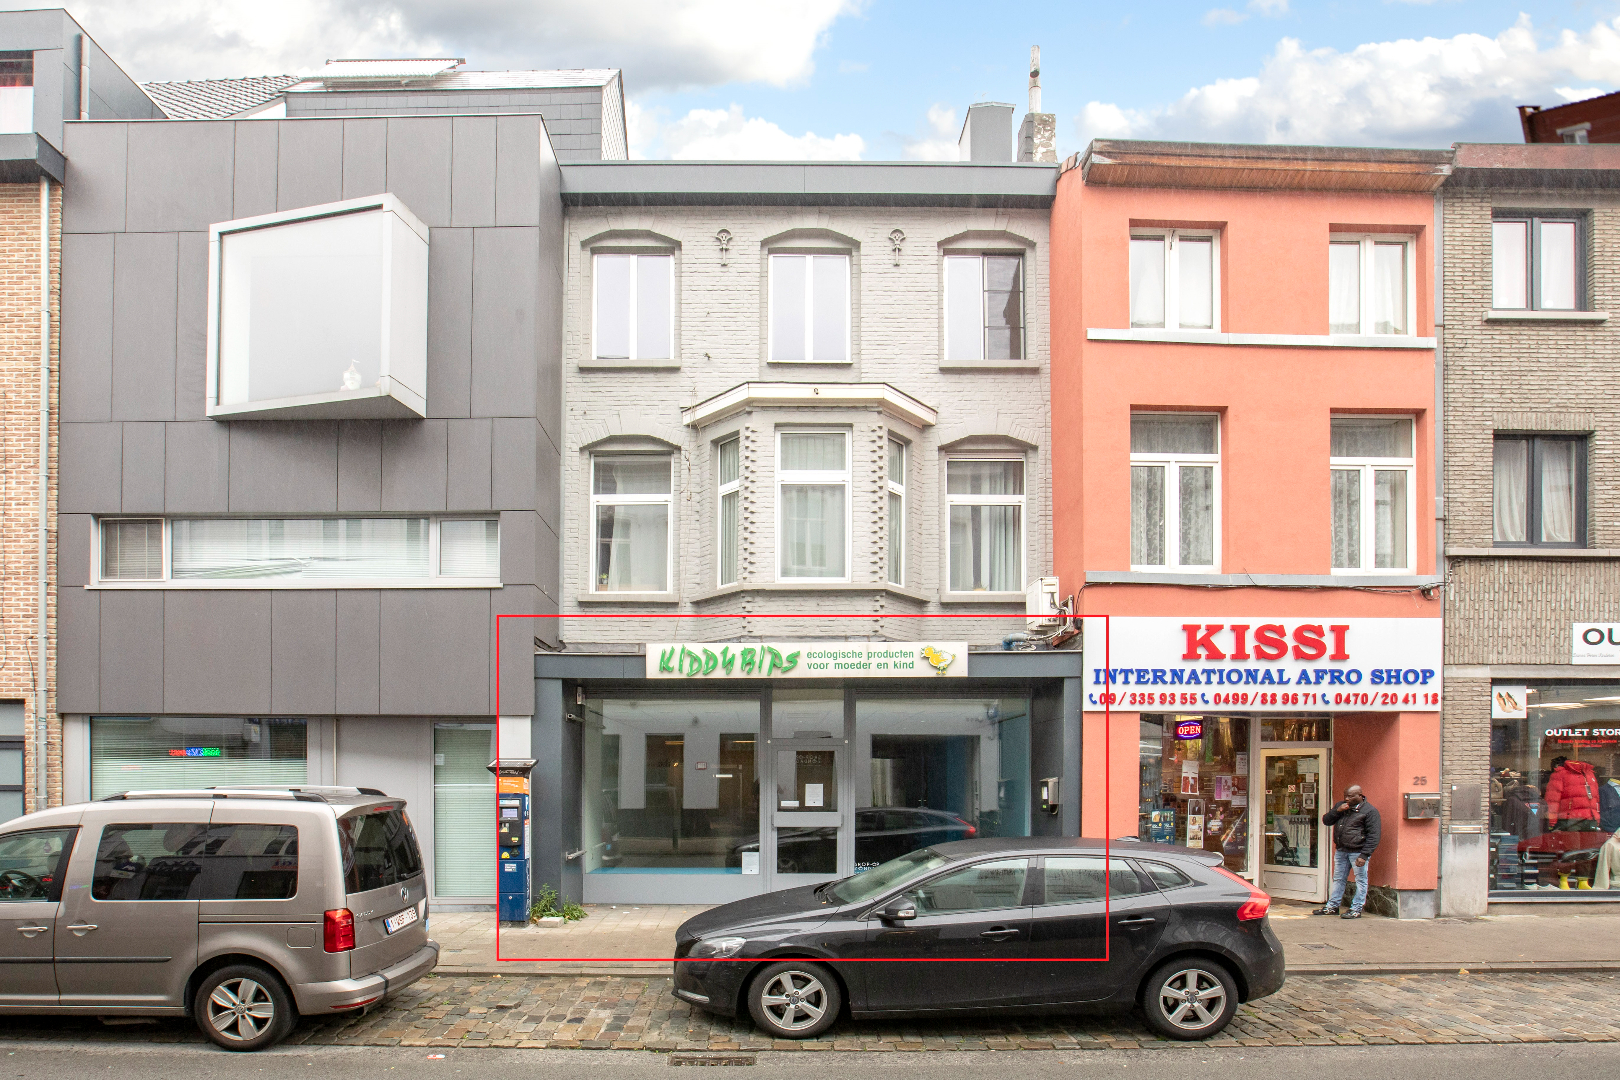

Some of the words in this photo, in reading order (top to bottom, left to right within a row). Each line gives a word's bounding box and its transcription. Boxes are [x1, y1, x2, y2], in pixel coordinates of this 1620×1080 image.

[1181, 624, 1350, 661] KISSI
[806, 650, 863, 661] ecologische
[867, 650, 914, 661] producten
[806, 662, 830, 670] voor
[834, 661, 872, 670] moeder
[876, 662, 889, 670] en
[893, 661, 914, 670] kind
[1093, 668, 1291, 685] INTERNATIONAL
[1296, 668, 1363, 685] AFRO
[1370, 668, 1435, 685] SHOP
[1178, 726, 1202, 735] OPEN
[1545, 728, 1589, 737] OUTLET
[1412, 776, 1428, 786] 25
